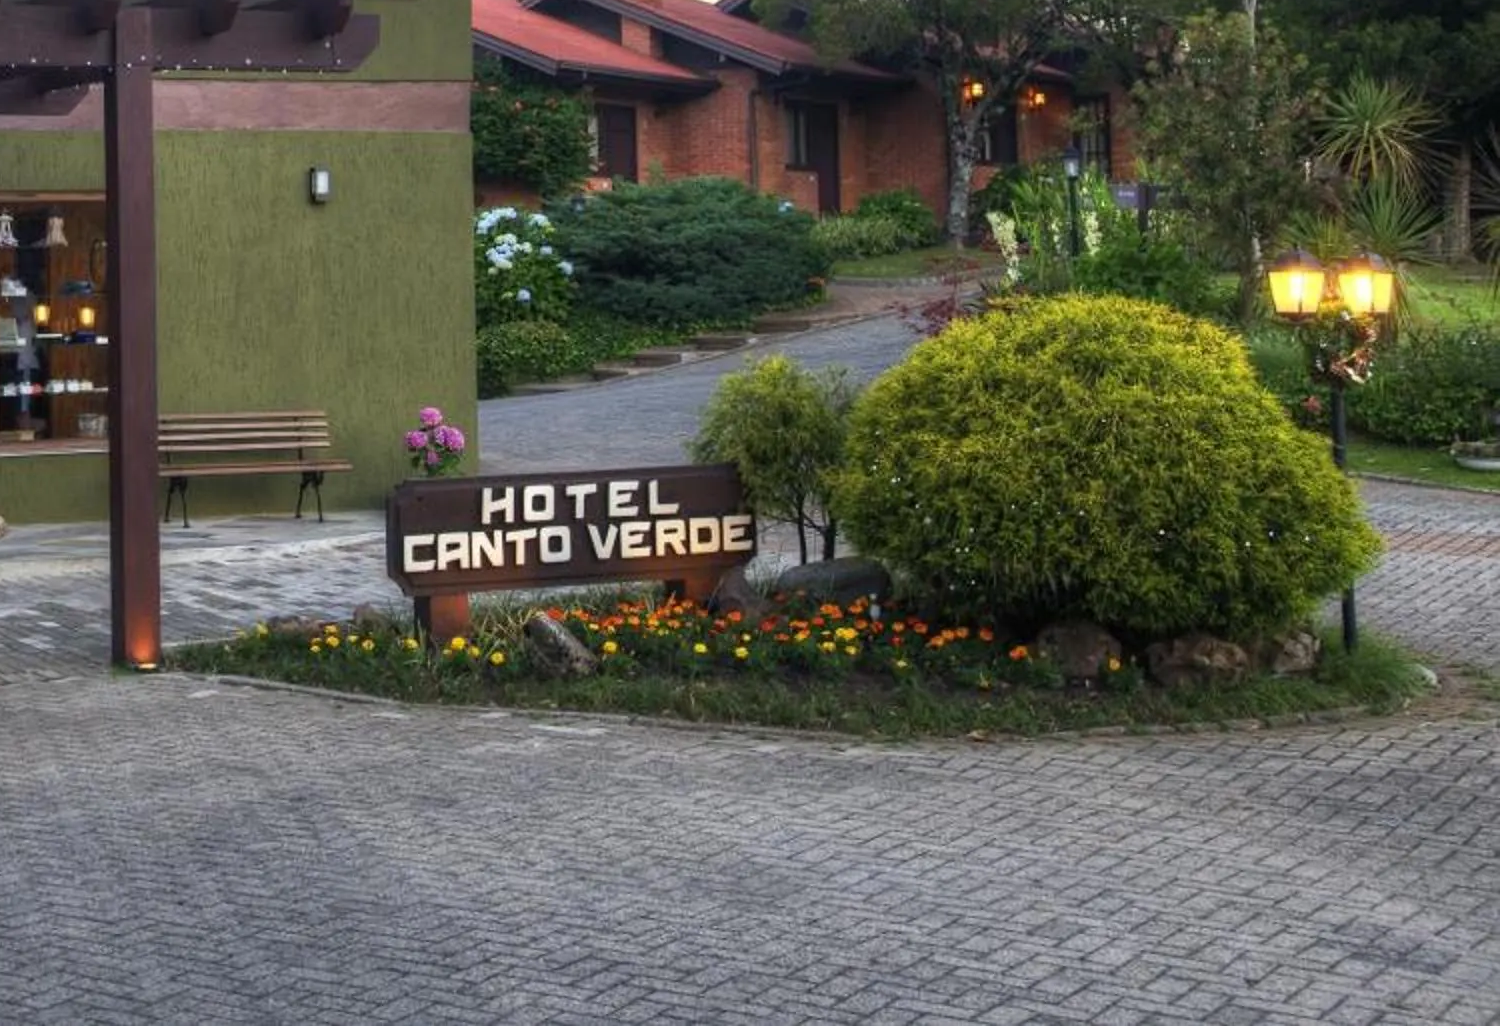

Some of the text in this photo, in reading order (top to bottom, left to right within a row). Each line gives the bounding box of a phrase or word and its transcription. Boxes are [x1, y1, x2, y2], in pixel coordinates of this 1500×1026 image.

[482, 479, 680, 525] HOTEL
[403, 515, 753, 573] CANTO VERDE
